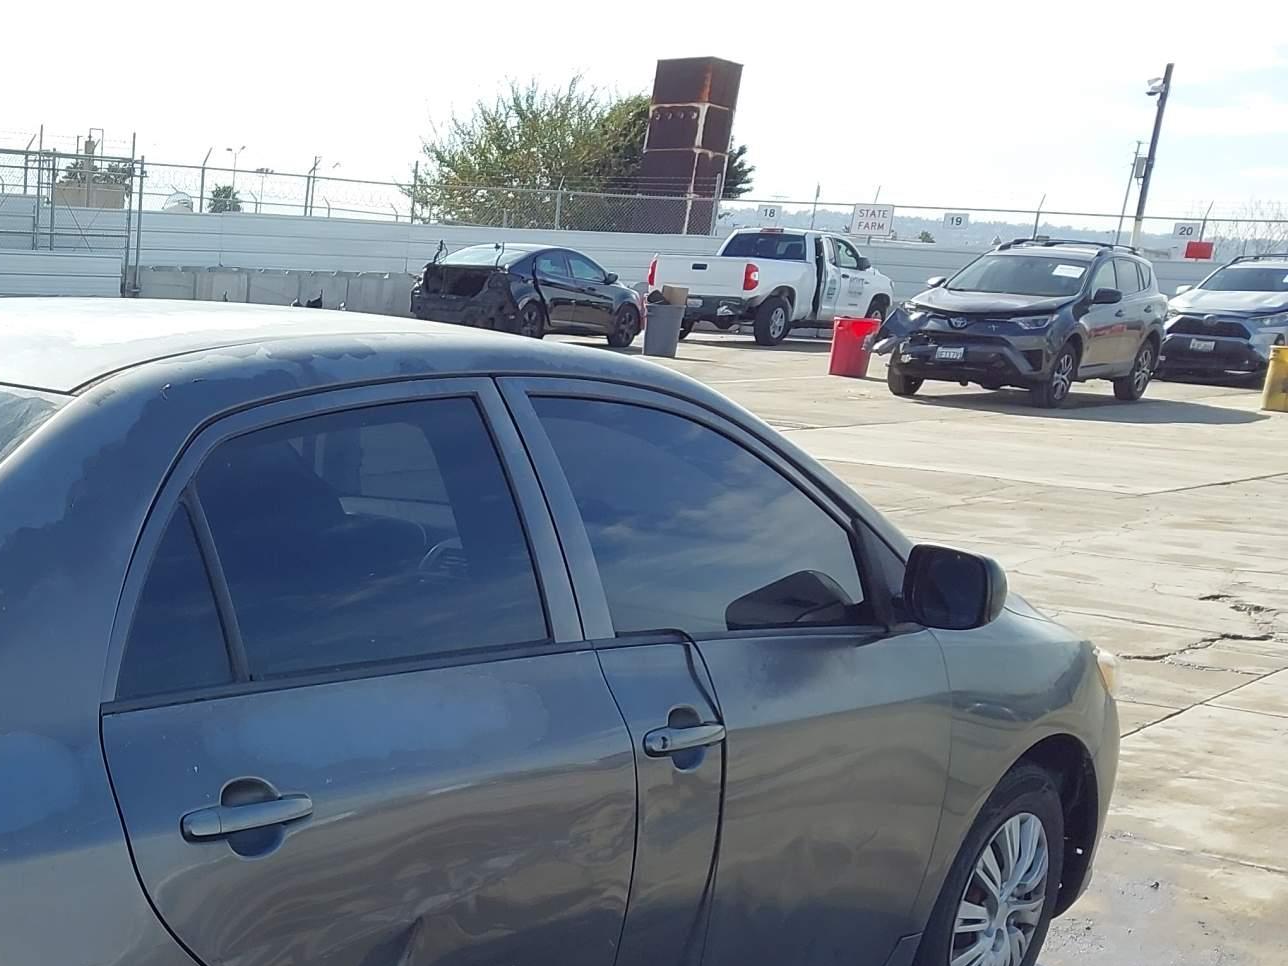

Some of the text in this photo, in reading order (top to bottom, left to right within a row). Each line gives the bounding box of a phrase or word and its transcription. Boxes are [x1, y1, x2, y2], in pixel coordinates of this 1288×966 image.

[763, 208, 776, 218] 18
[858, 208, 889, 219] STATE
[857, 221, 885, 231] FARM
[950, 216, 963, 226] 19
[1178, 226, 1194, 236] 20
